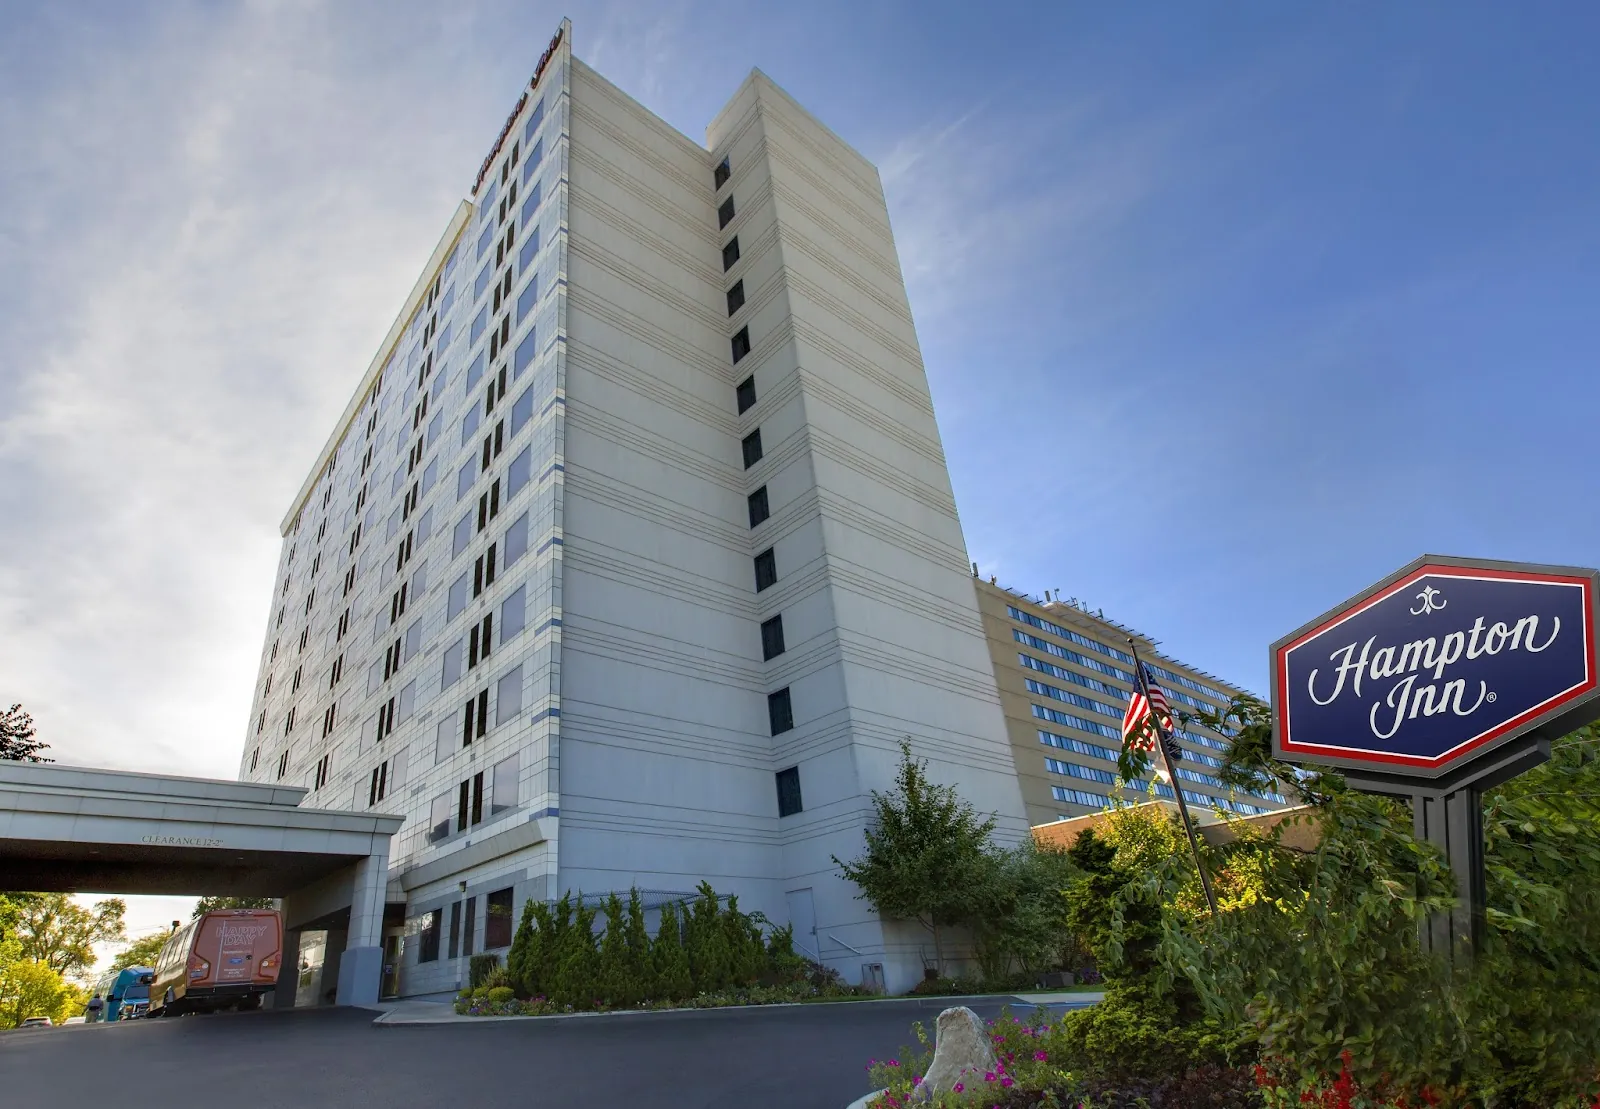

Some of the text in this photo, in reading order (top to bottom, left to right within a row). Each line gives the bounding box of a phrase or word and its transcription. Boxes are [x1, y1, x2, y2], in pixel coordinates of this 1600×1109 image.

[1308, 615, 1560, 706] Hampton
[141, 835, 201, 846] CLEARANCE
[224, 934, 256, 945] DAY
